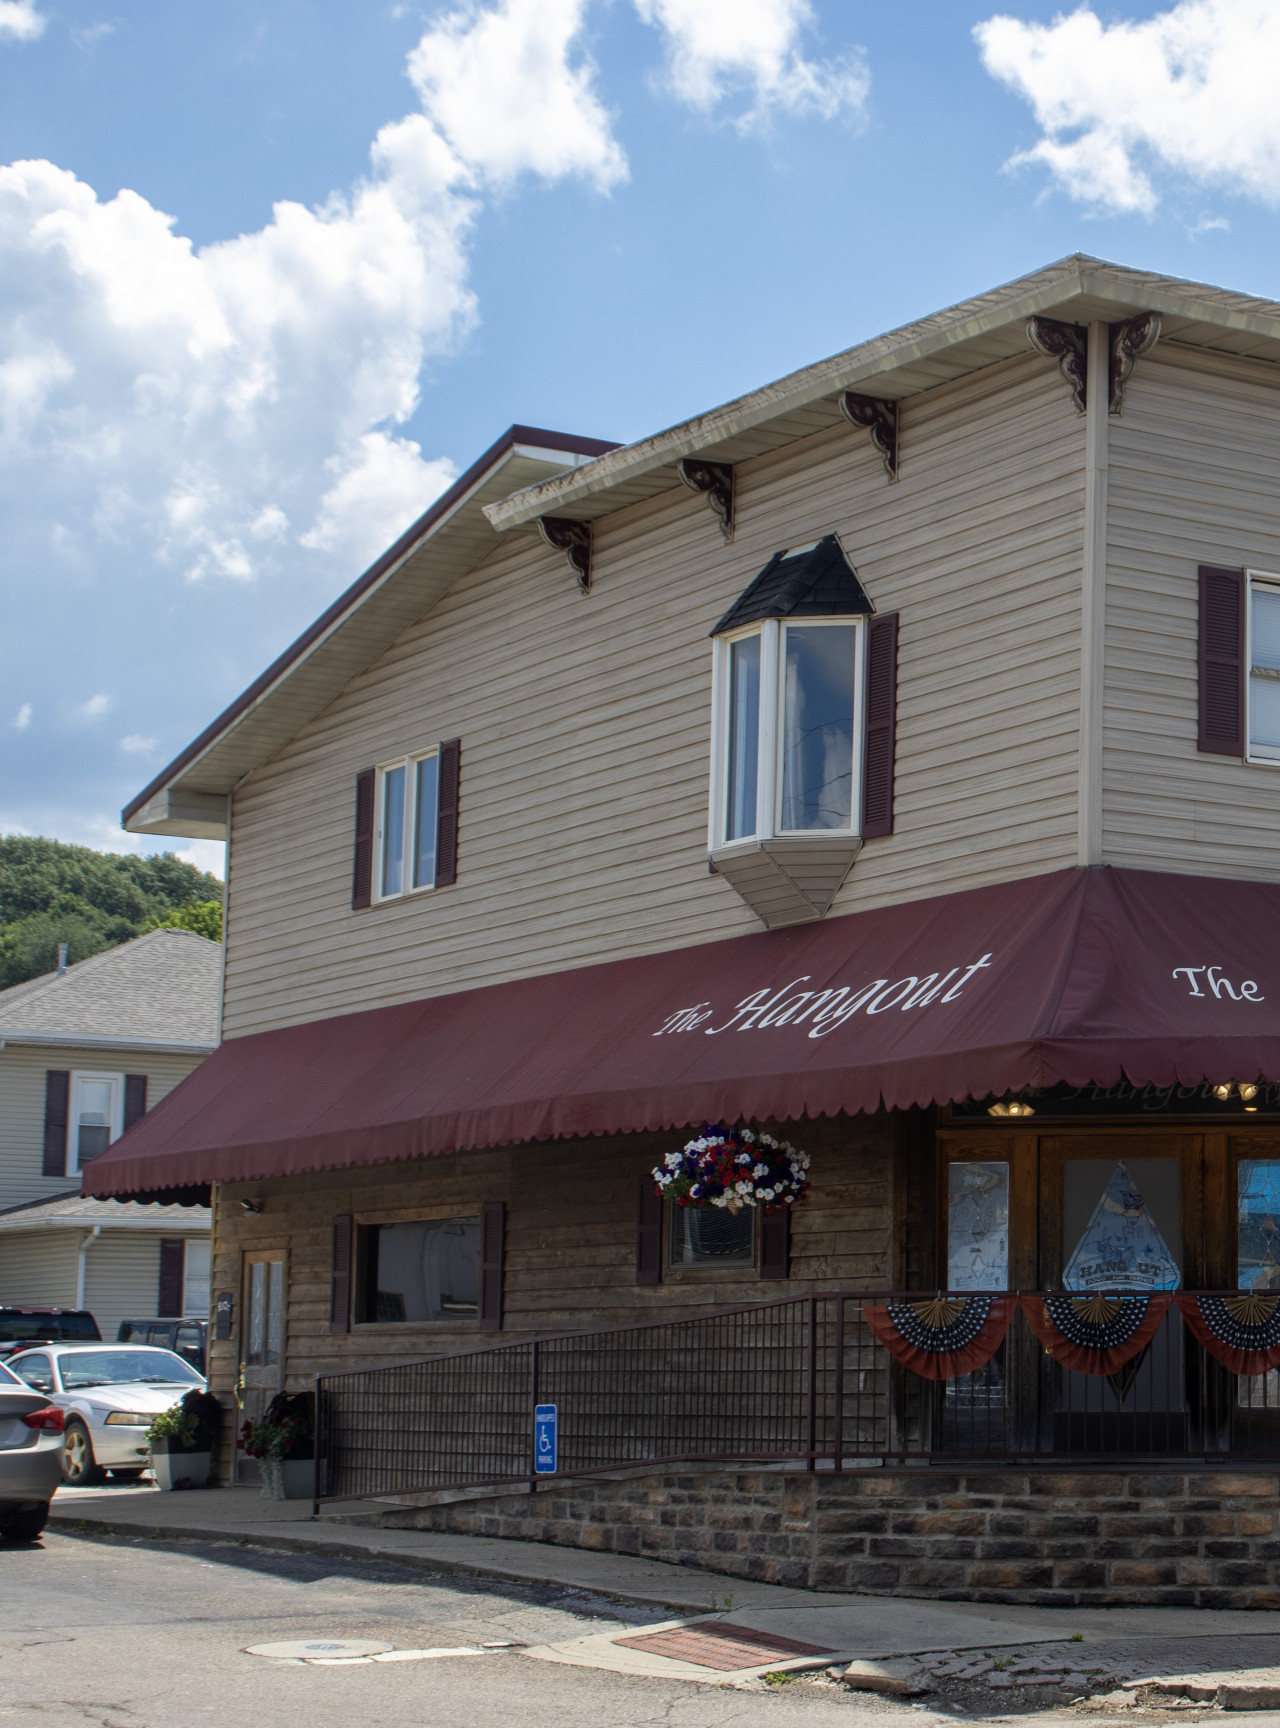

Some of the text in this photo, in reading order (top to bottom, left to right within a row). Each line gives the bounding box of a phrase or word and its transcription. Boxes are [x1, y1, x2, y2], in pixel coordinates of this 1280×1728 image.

[652, 952, 993, 1039] The Hangout
[1172, 965, 1265, 1002] The
[1080, 1260, 1162, 1278] HANGUT
